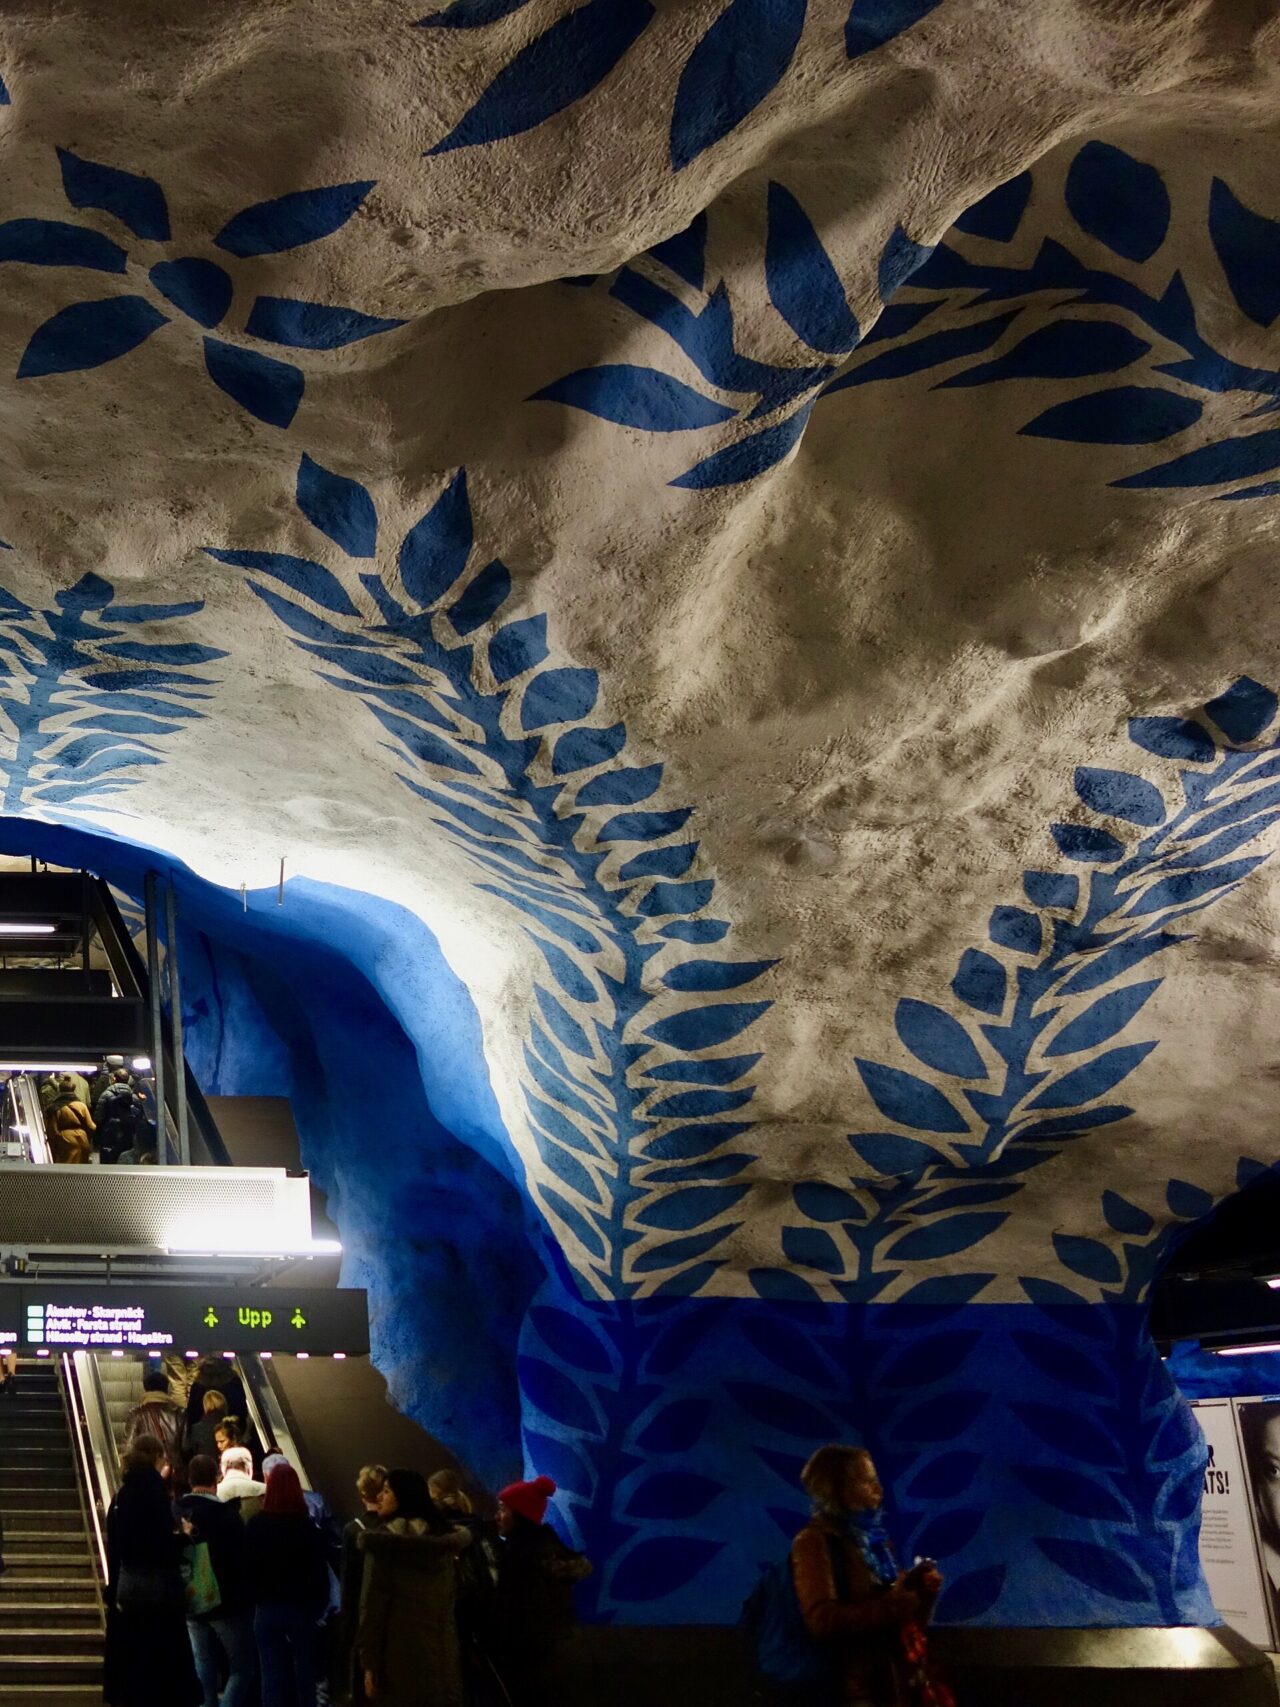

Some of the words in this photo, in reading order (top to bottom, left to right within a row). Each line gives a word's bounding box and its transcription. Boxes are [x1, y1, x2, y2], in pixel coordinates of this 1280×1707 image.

[92, 1306, 144, 1319] Skarpnäck
[238, 1307, 272, 1328] Upp
[46, 1318, 71, 1330] Alvik
[77, 1319, 108, 1330] Farsta
[110, 1319, 141, 1330] strand
[91, 1332, 122, 1343] strand
